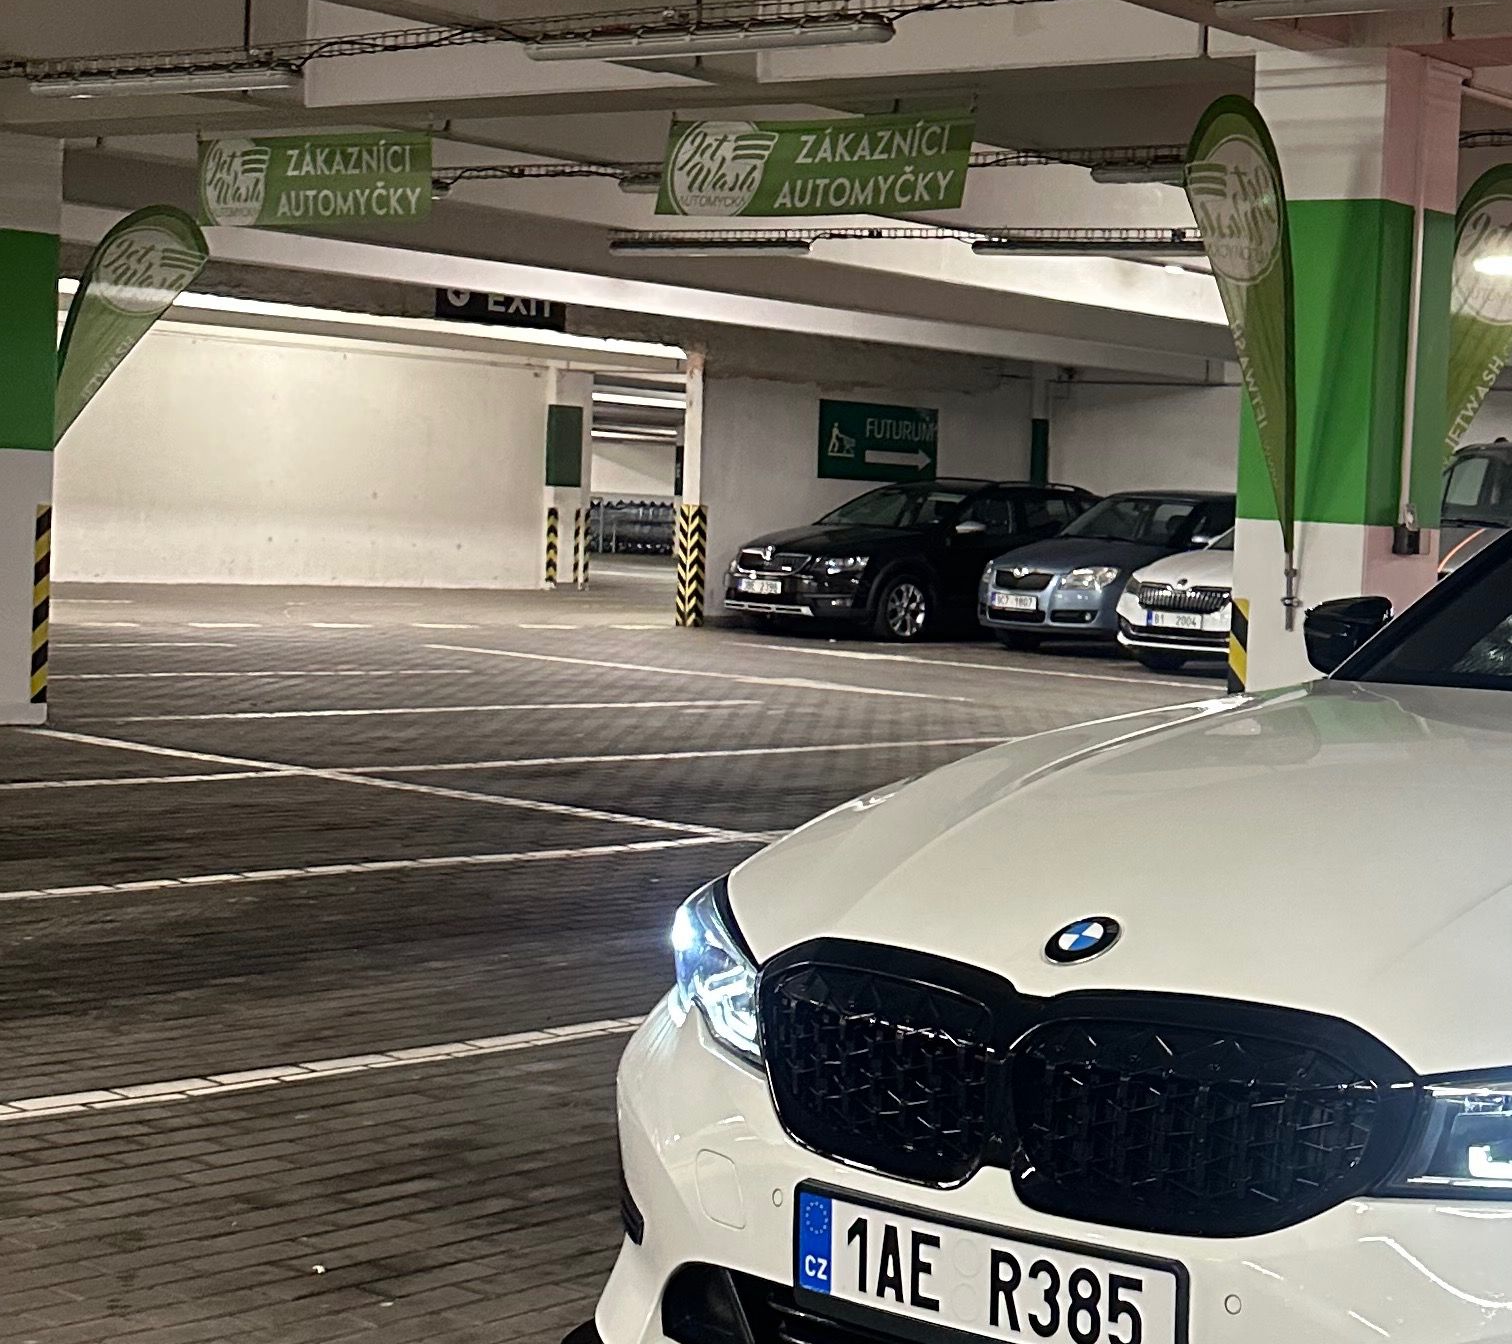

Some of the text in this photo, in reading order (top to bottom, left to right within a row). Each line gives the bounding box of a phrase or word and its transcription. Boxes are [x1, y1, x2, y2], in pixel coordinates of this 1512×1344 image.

[286, 140, 412, 177] ZÁKAZNÍCI
[795, 120, 951, 164] ZÁKAZNÍCI
[686, 156, 758, 192] Wash
[773, 166, 954, 208] AUTOMYČKY
[277, 181, 422, 217] AUTOMYČKY
[804, 1254, 828, 1282] CZ
[847, 1217, 941, 1312] 1AE
